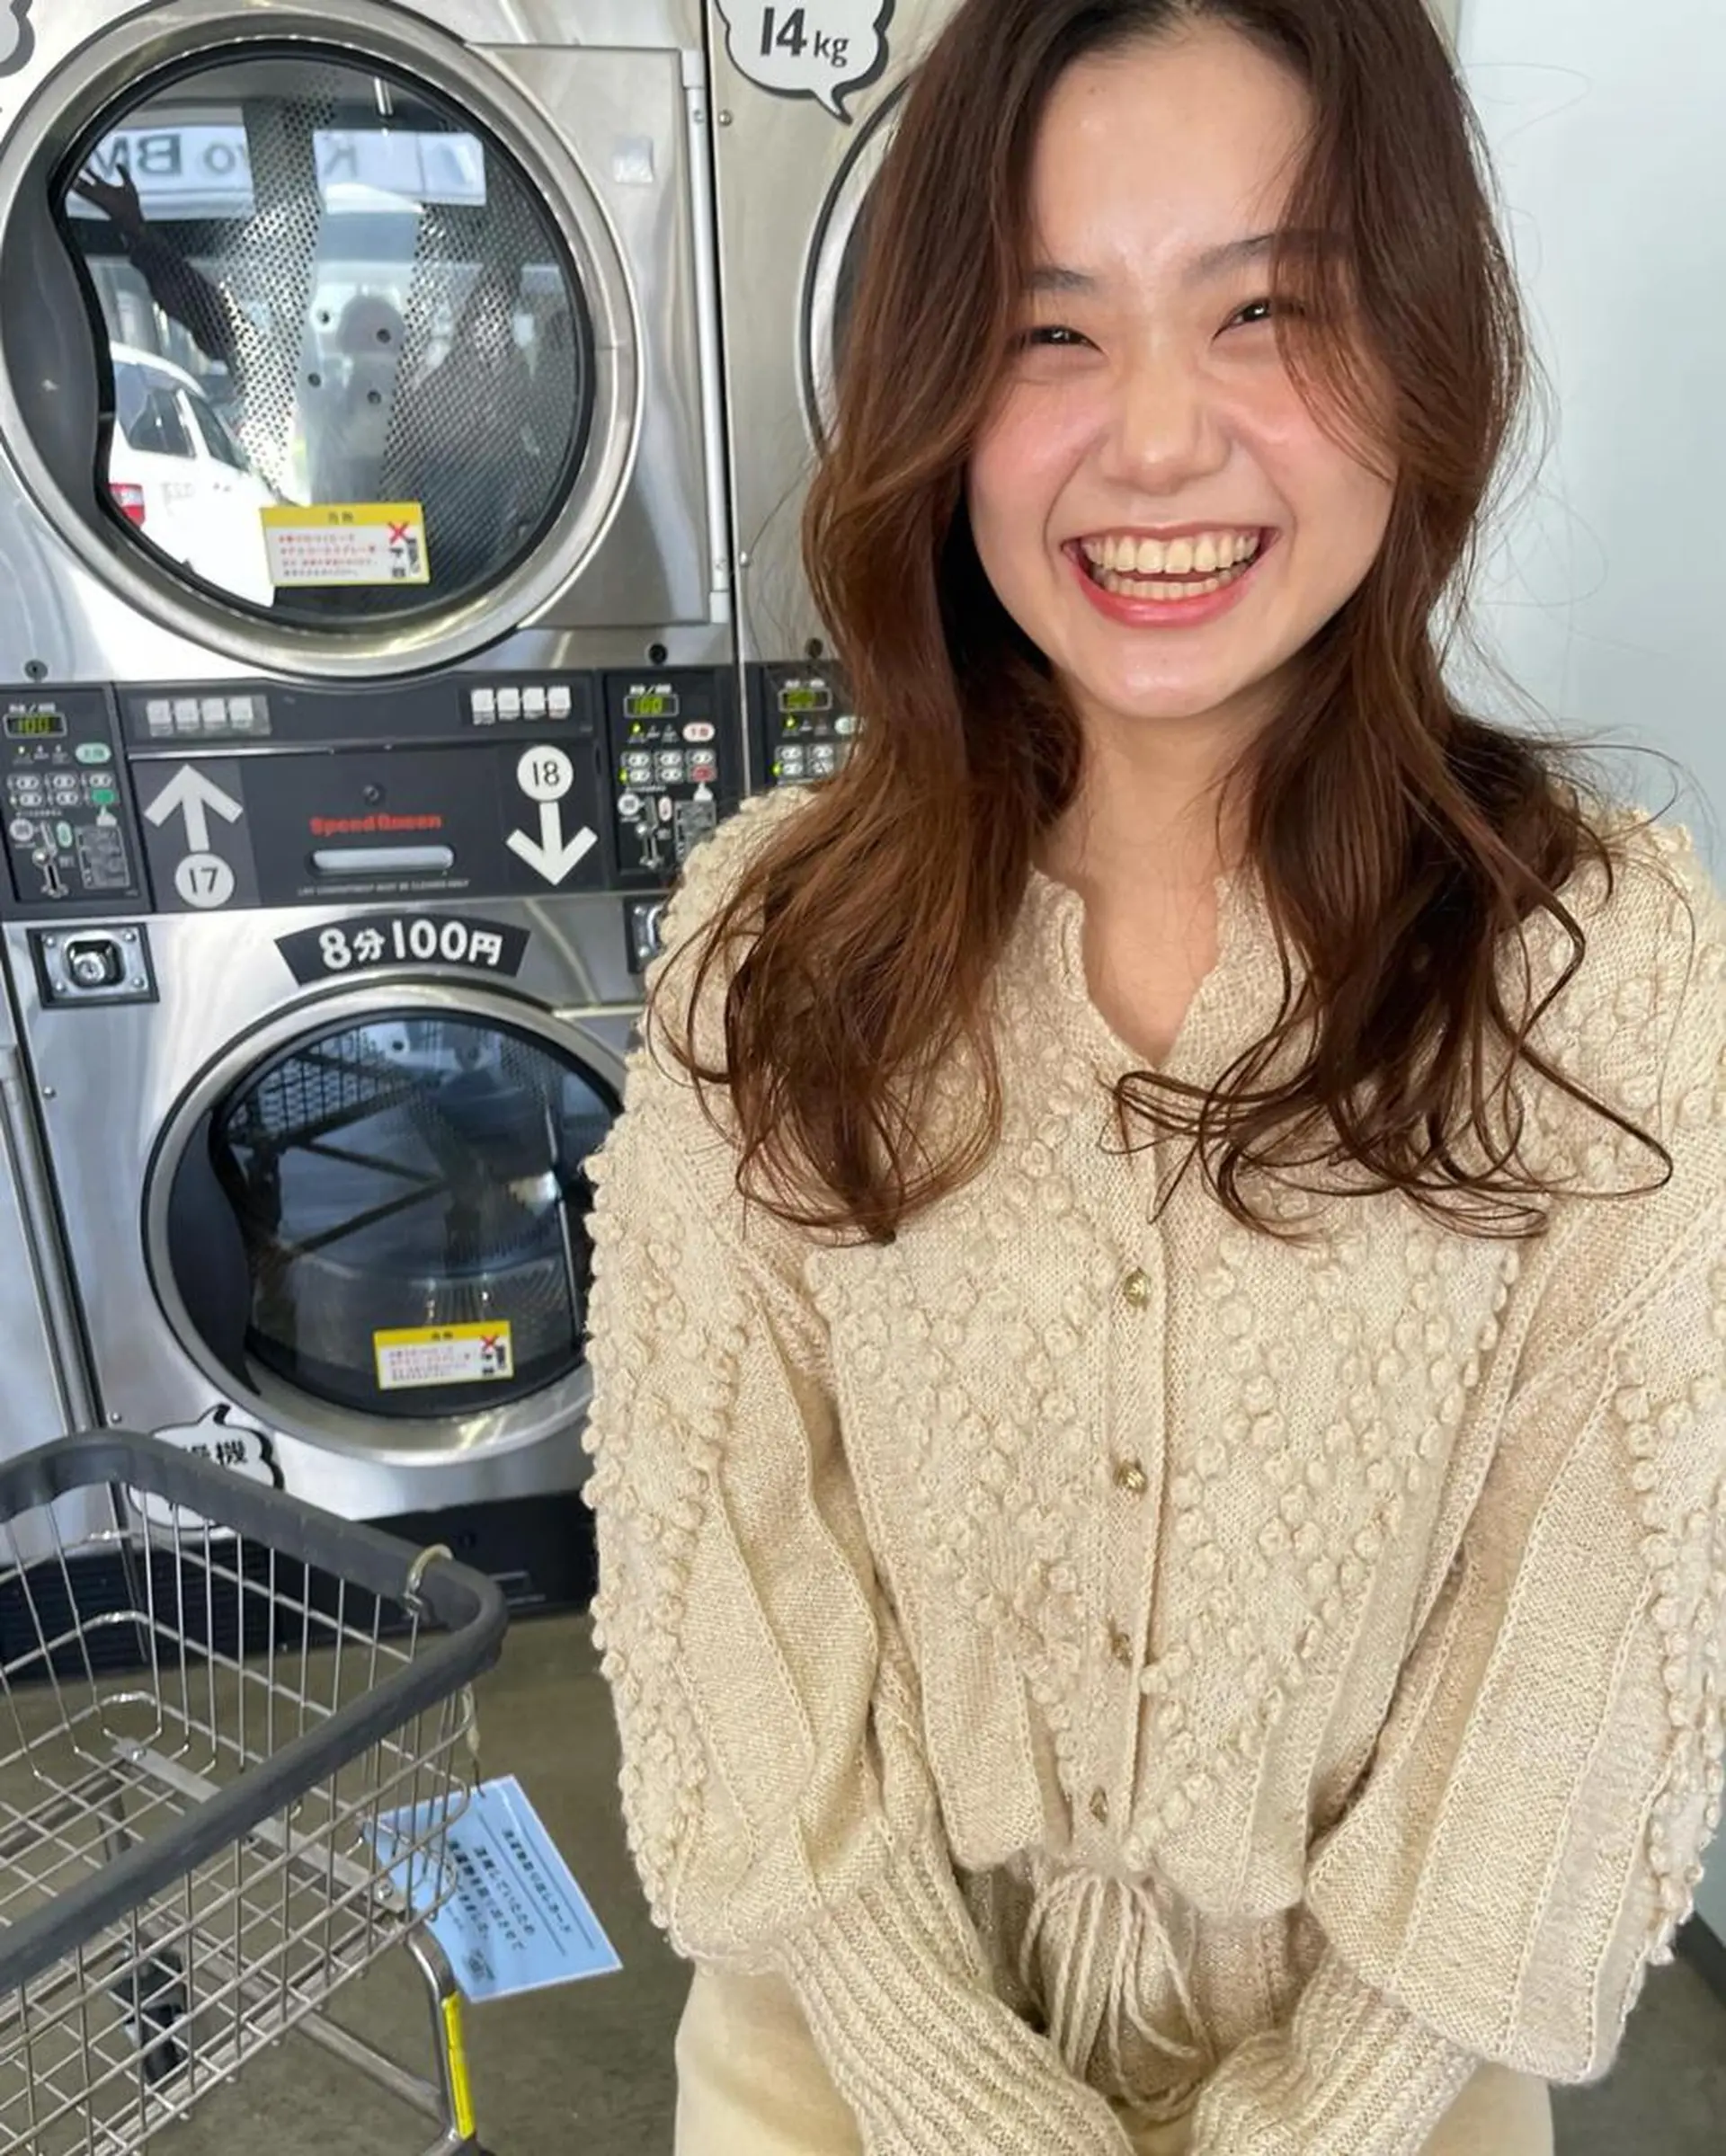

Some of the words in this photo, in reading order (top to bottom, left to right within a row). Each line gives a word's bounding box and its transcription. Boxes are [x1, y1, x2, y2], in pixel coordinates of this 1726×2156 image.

[761, 7, 807, 57] 14
[814, 31, 850, 67] kg
[532, 760, 560, 787] 18
[189, 867, 218, 894] 17
[318, 918, 503, 971] 8分100円
